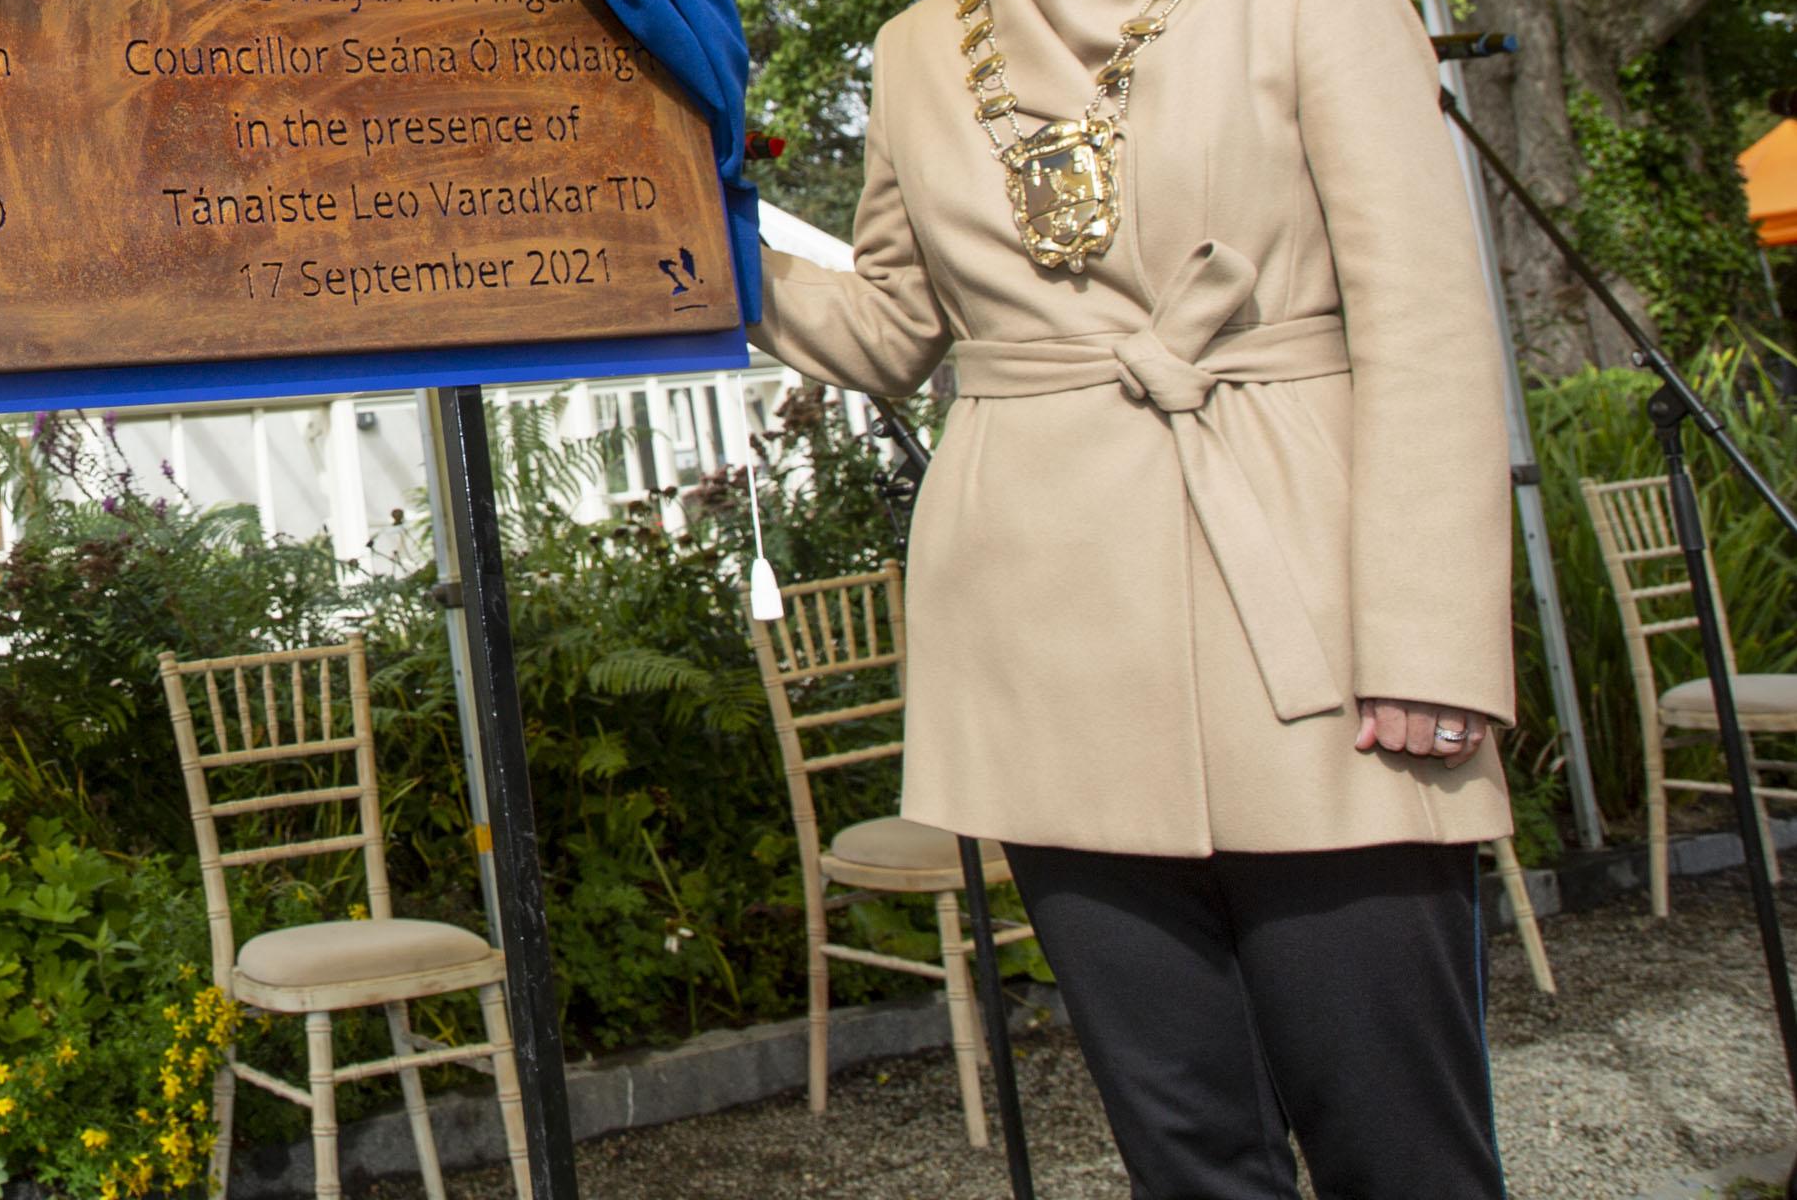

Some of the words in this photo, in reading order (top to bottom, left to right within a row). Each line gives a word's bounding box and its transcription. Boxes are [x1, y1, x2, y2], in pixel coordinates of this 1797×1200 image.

[124, 37, 330, 78] Councillor
[344, 37, 457, 78] Seána
[470, 28, 500, 73] Ó
[233, 111, 272, 150] in
[283, 109, 349, 149] the
[362, 113, 534, 156] presence
[546, 105, 581, 143] of
[162, 182, 337, 227] Tánaiste
[352, 183, 421, 223] Leo
[428, 176, 598, 218] Varadkar
[608, 175, 658, 211] TD
[238, 261, 284, 301] 17
[301, 252, 515, 306] September
[527, 246, 613, 287] 2021
